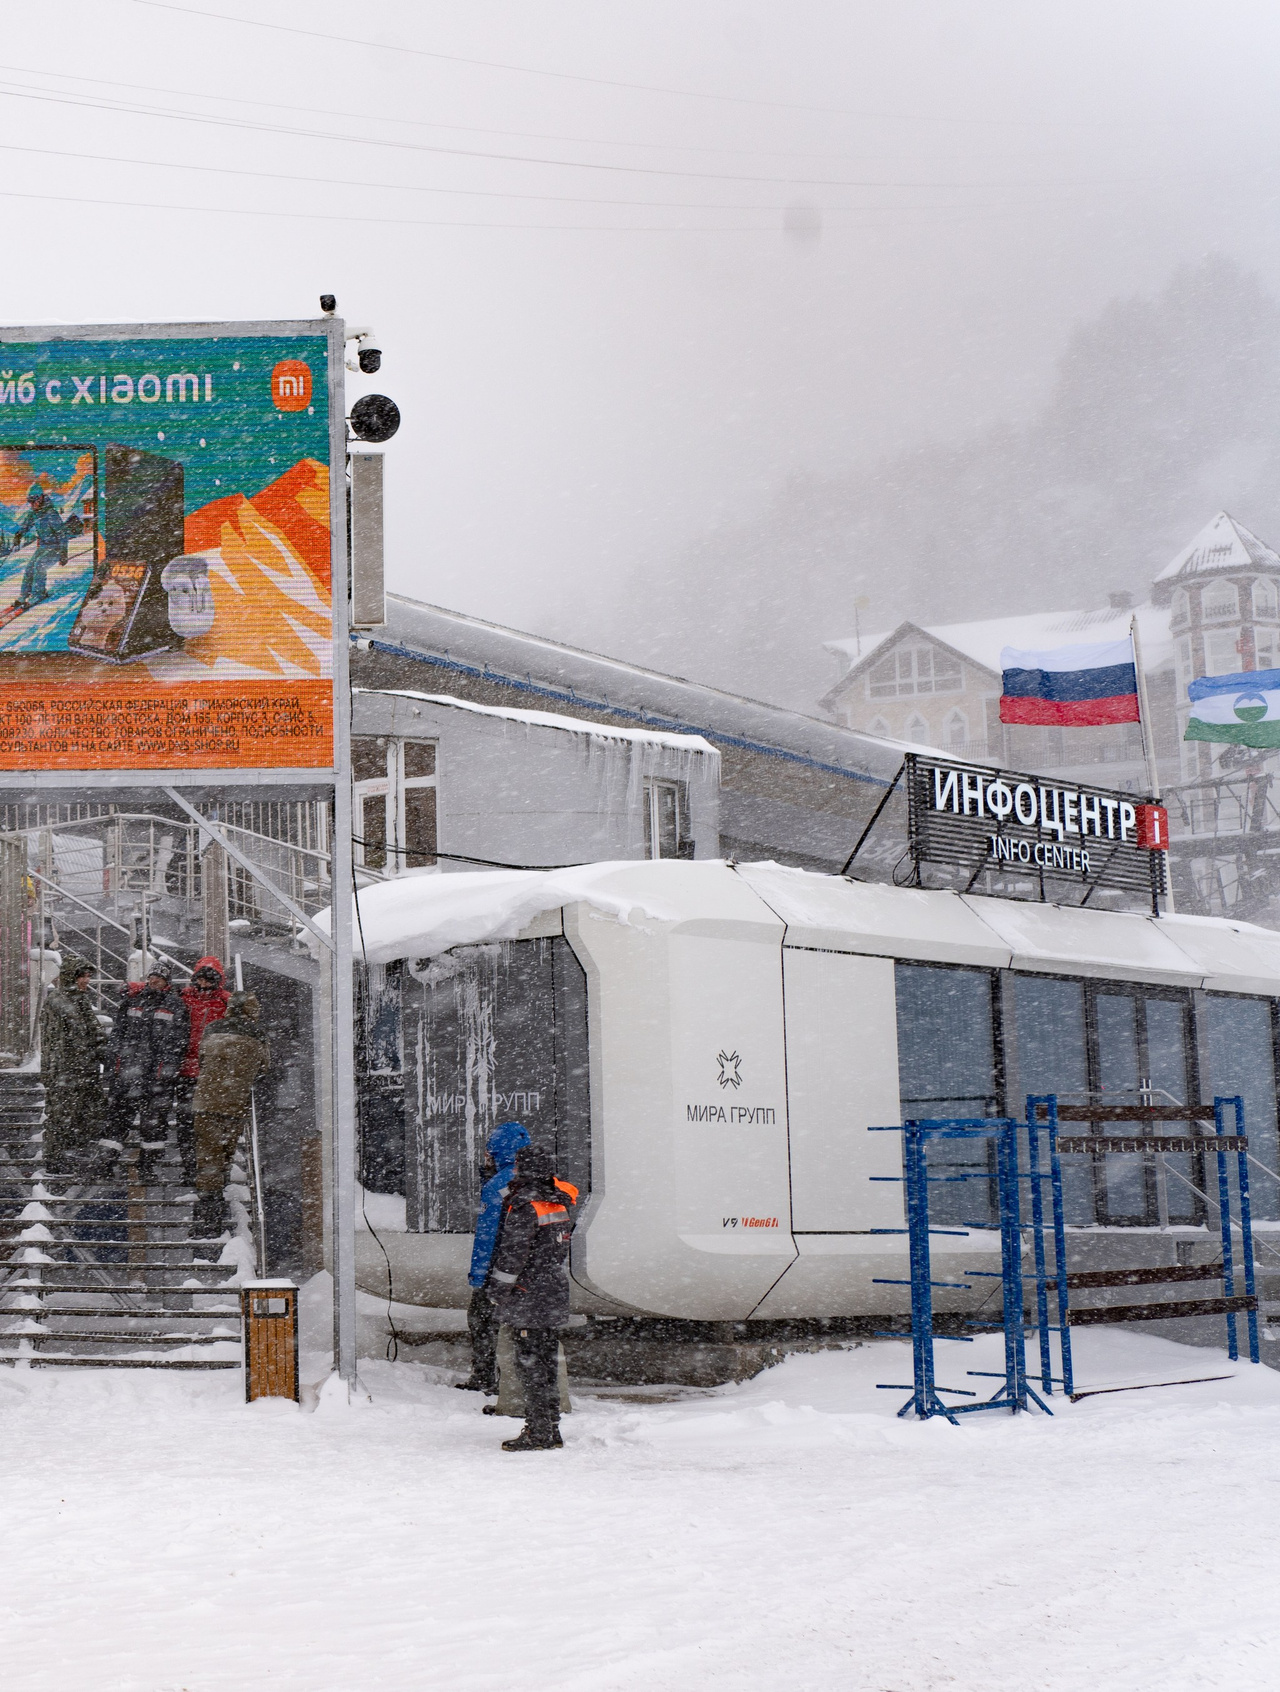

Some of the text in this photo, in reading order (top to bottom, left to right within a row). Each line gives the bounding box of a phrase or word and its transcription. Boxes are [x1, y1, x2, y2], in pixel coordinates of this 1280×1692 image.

[45, 380, 62, 404] с
[51, 698, 123, 711] РОССИЙСКАЯ
[194, 696, 270, 710] ПРИМОРСКИЙ
[166, 711, 191, 725] ДОМ
[216, 711, 258, 724] КОРПУС
[273, 710, 304, 723] ОФИС
[39, 726, 110, 739] КОЛИЧЕСТВО
[113, 726, 163, 738] ТОВАРОВ
[241, 725, 324, 739] ПОДРОБНОСТИ
[81, 740, 97, 752] НА
[99, 739, 133, 752] САЙТЕ
[934, 768, 1136, 841] ИНФОЦЕНТР
[992, 836, 1091, 872] INFO CENTER
[479, 1091, 540, 1113] РУПП
[687, 1104, 776, 1125] МИРА ГРУПП
[722, 1217, 739, 1229] V9
